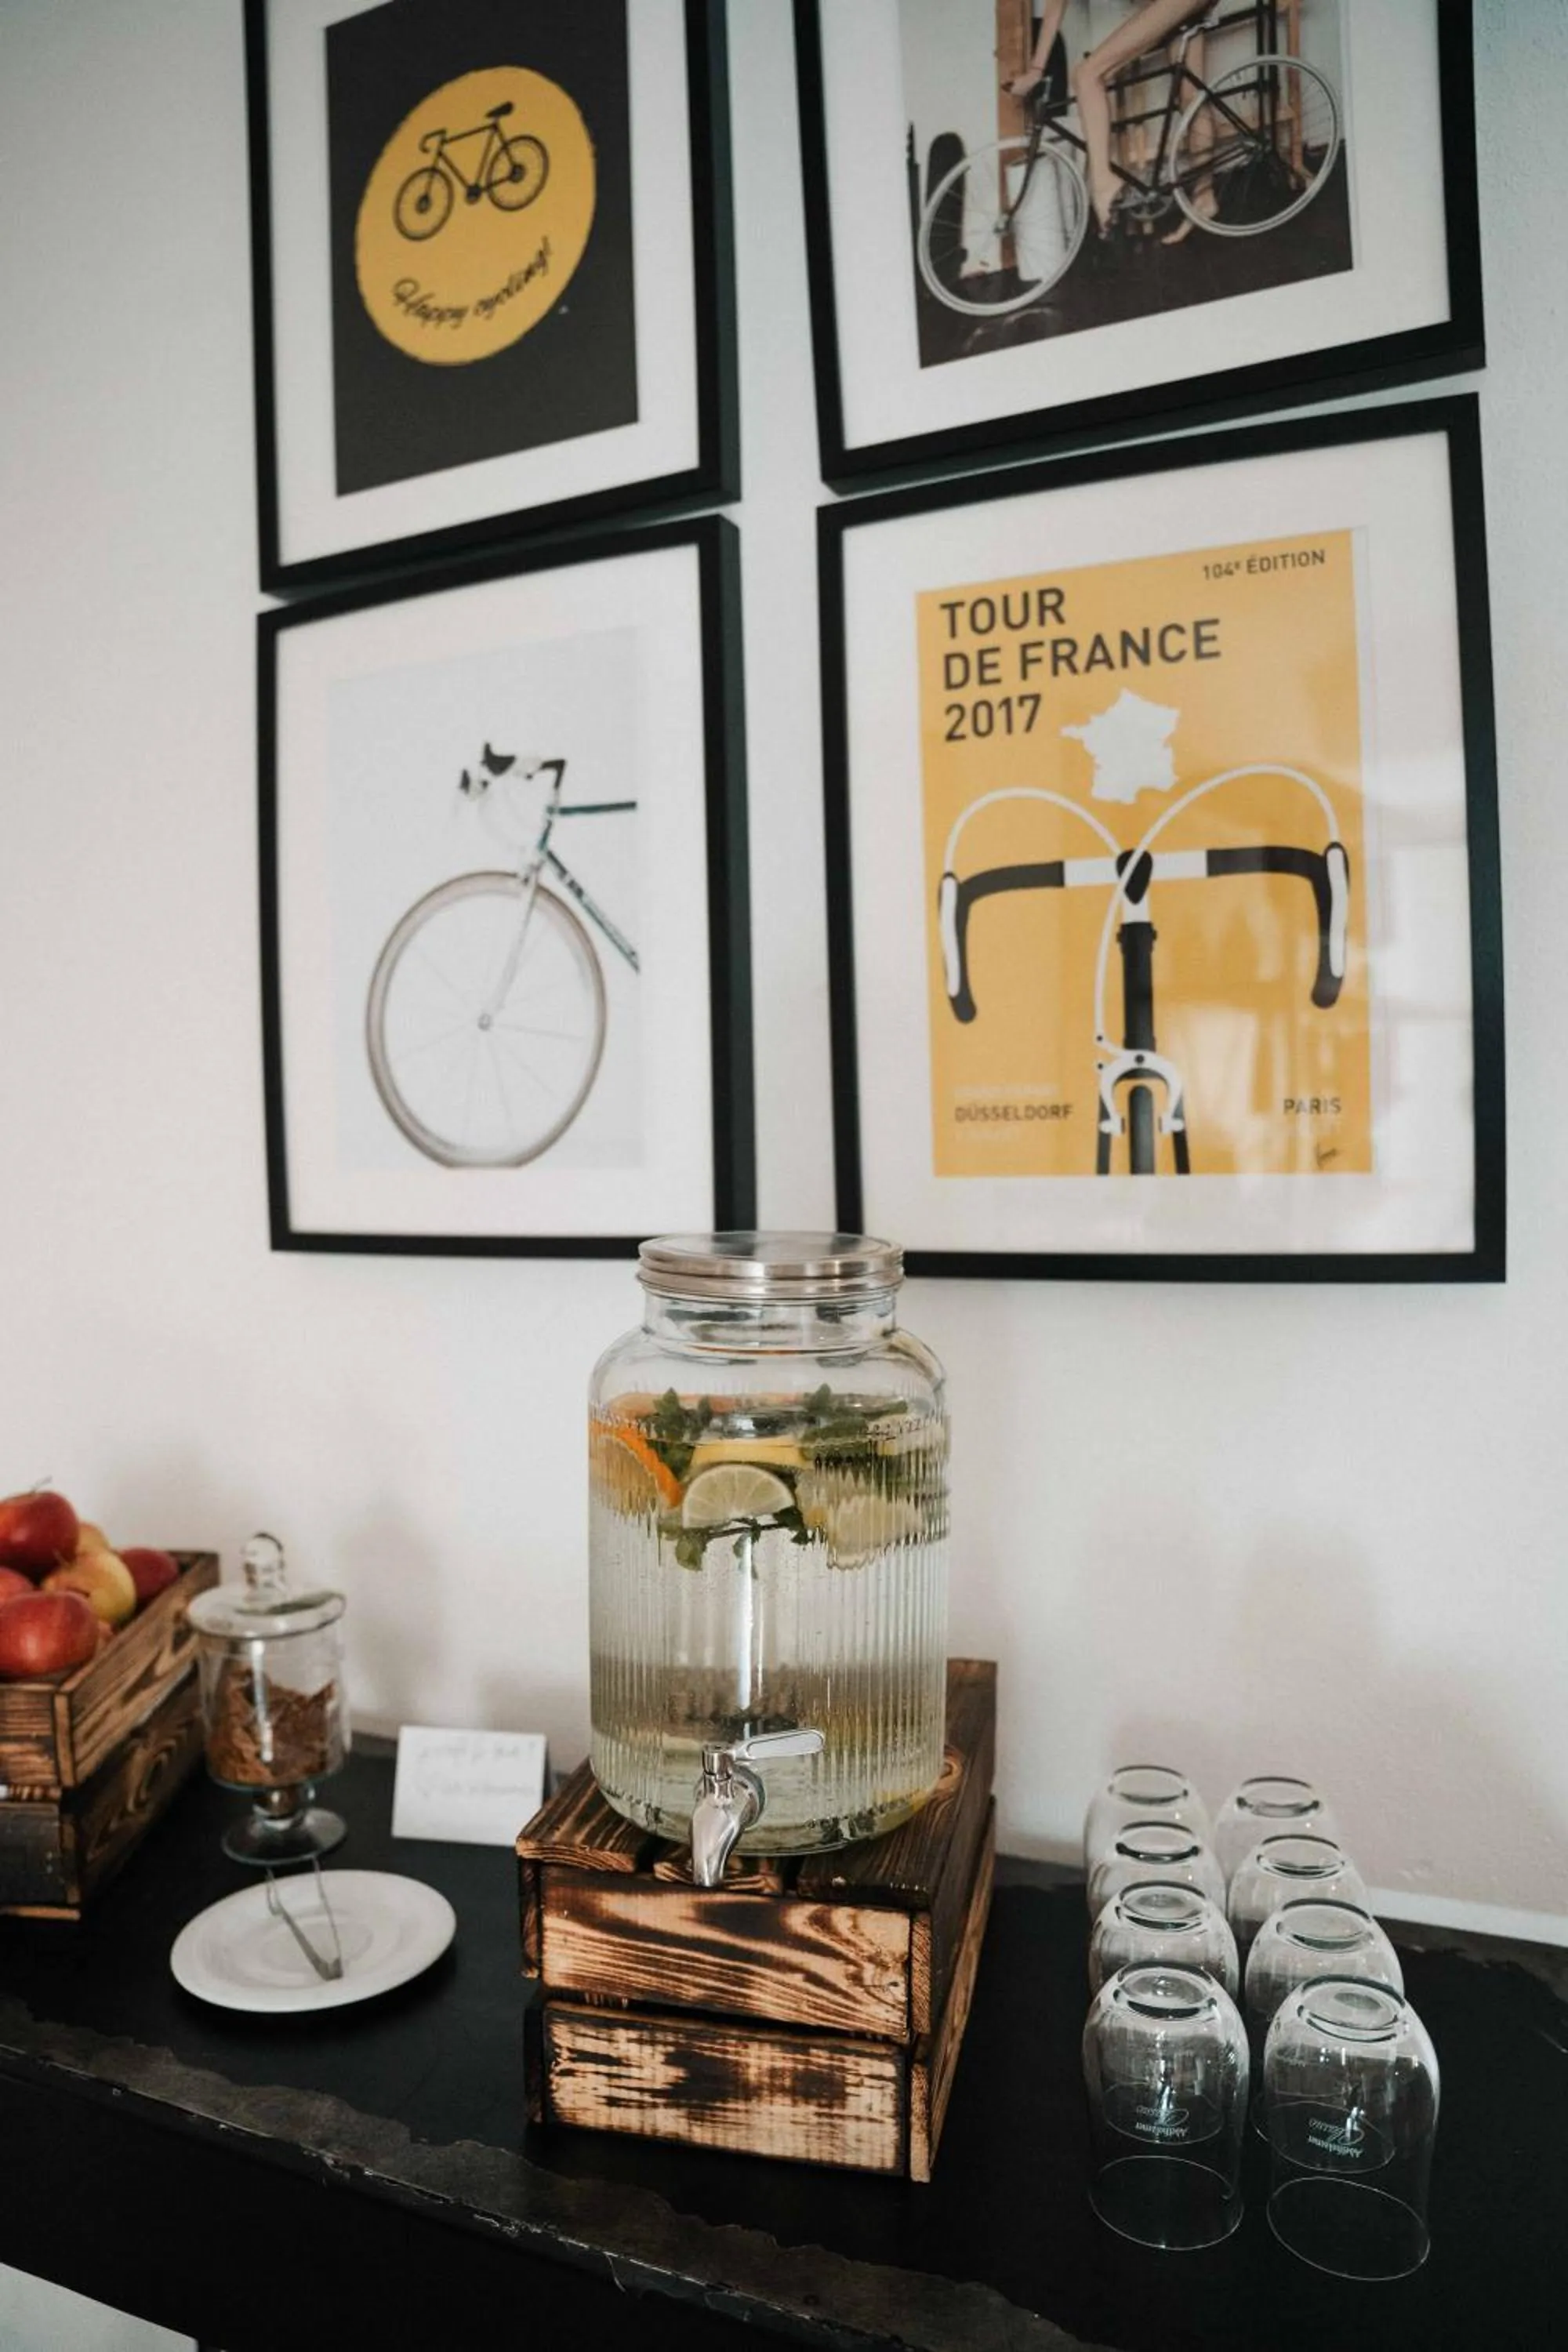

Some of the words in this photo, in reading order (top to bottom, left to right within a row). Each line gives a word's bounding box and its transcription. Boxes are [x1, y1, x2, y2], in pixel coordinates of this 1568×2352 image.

[1246, 549, 1326, 575] ÉDITION
[940, 586, 1066, 640] TOUR
[943, 646, 1003, 691] DE
[1019, 618, 1222, 681] FRANCE
[944, 693, 1043, 742] 2017
[954, 1102, 1073, 1123] DÜSSELDORF
[1283, 1097, 1342, 1116] PARIS
